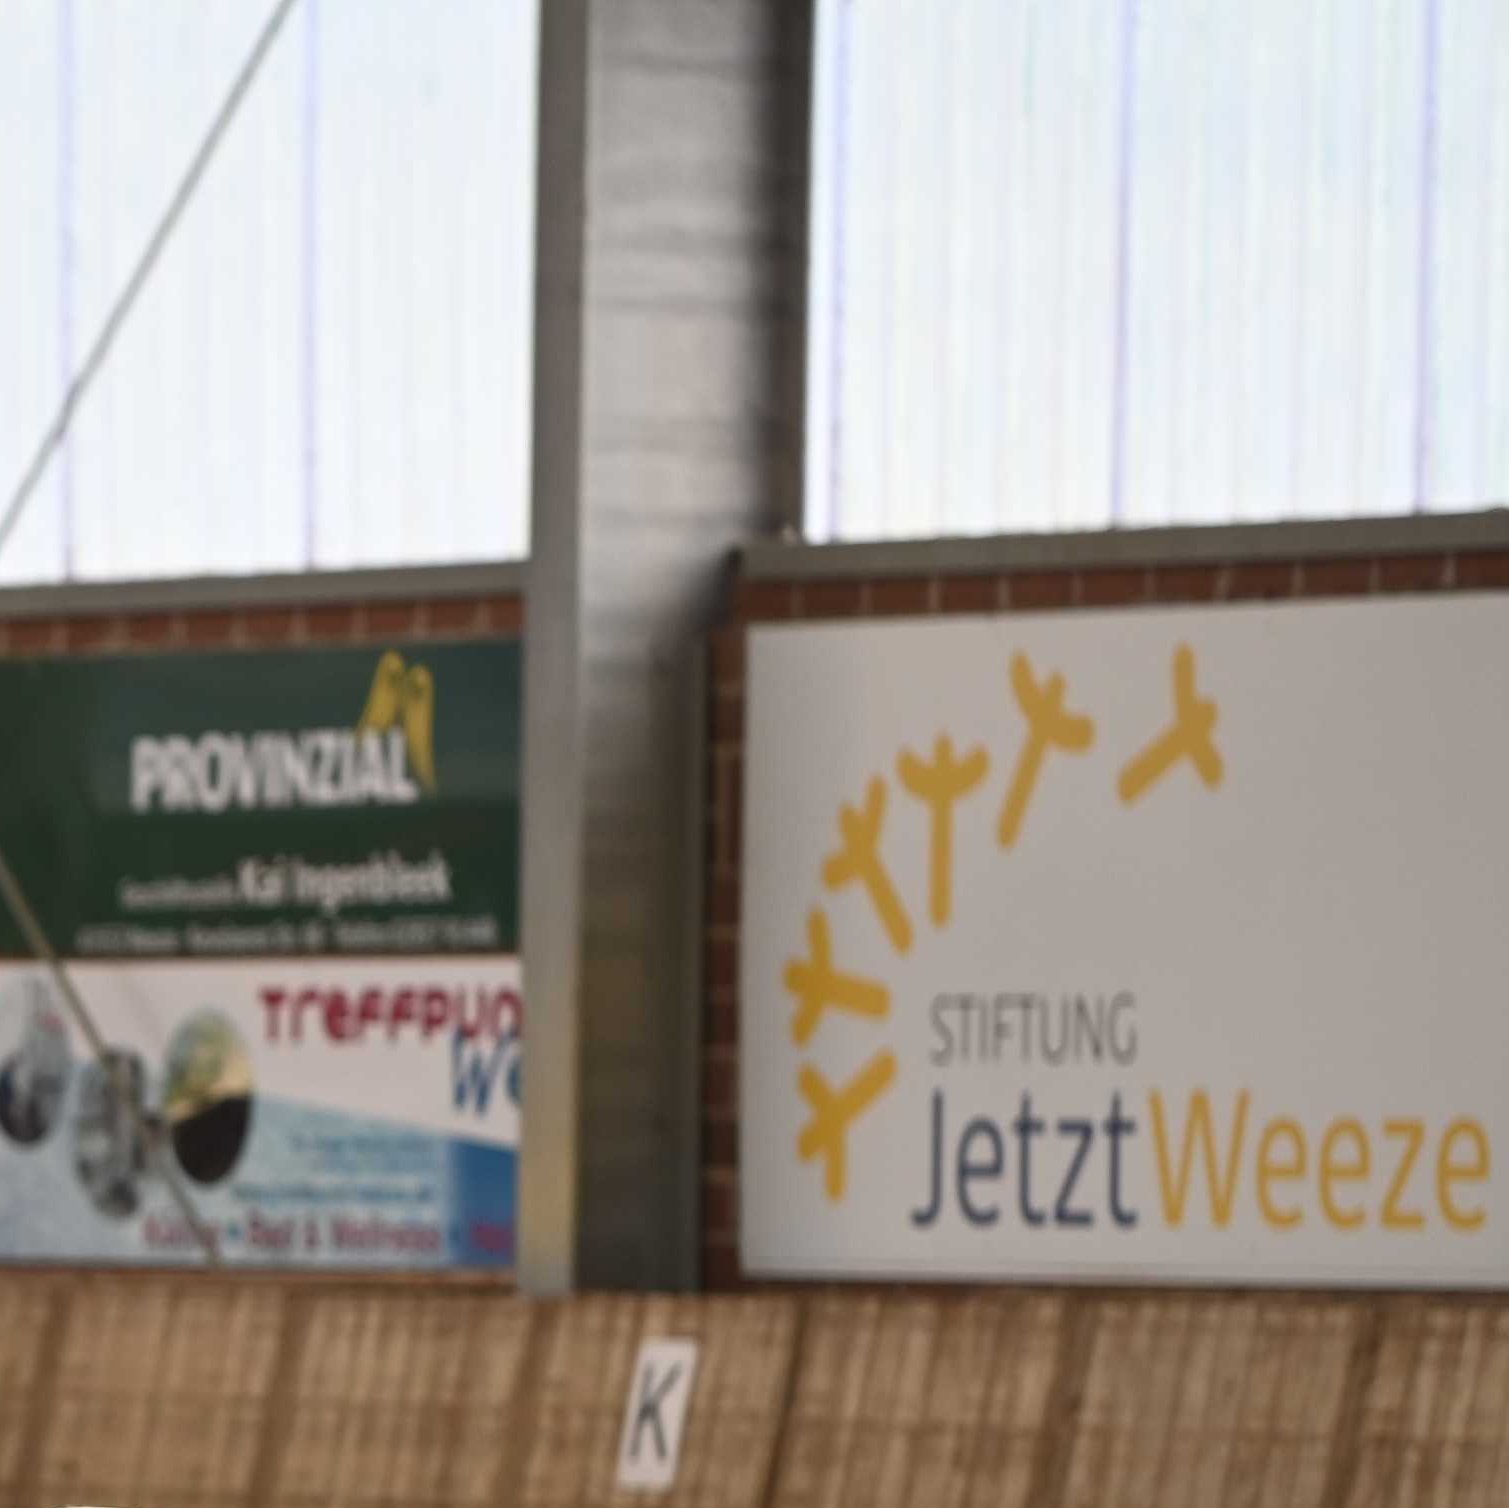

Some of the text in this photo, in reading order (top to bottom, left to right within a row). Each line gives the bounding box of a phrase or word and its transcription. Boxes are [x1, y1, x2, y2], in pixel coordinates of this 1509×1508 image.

[131, 731, 419, 808] PROVINZIAL
[929, 990, 1138, 1068] STIFTUNG
[626, 1360, 686, 1464] K
